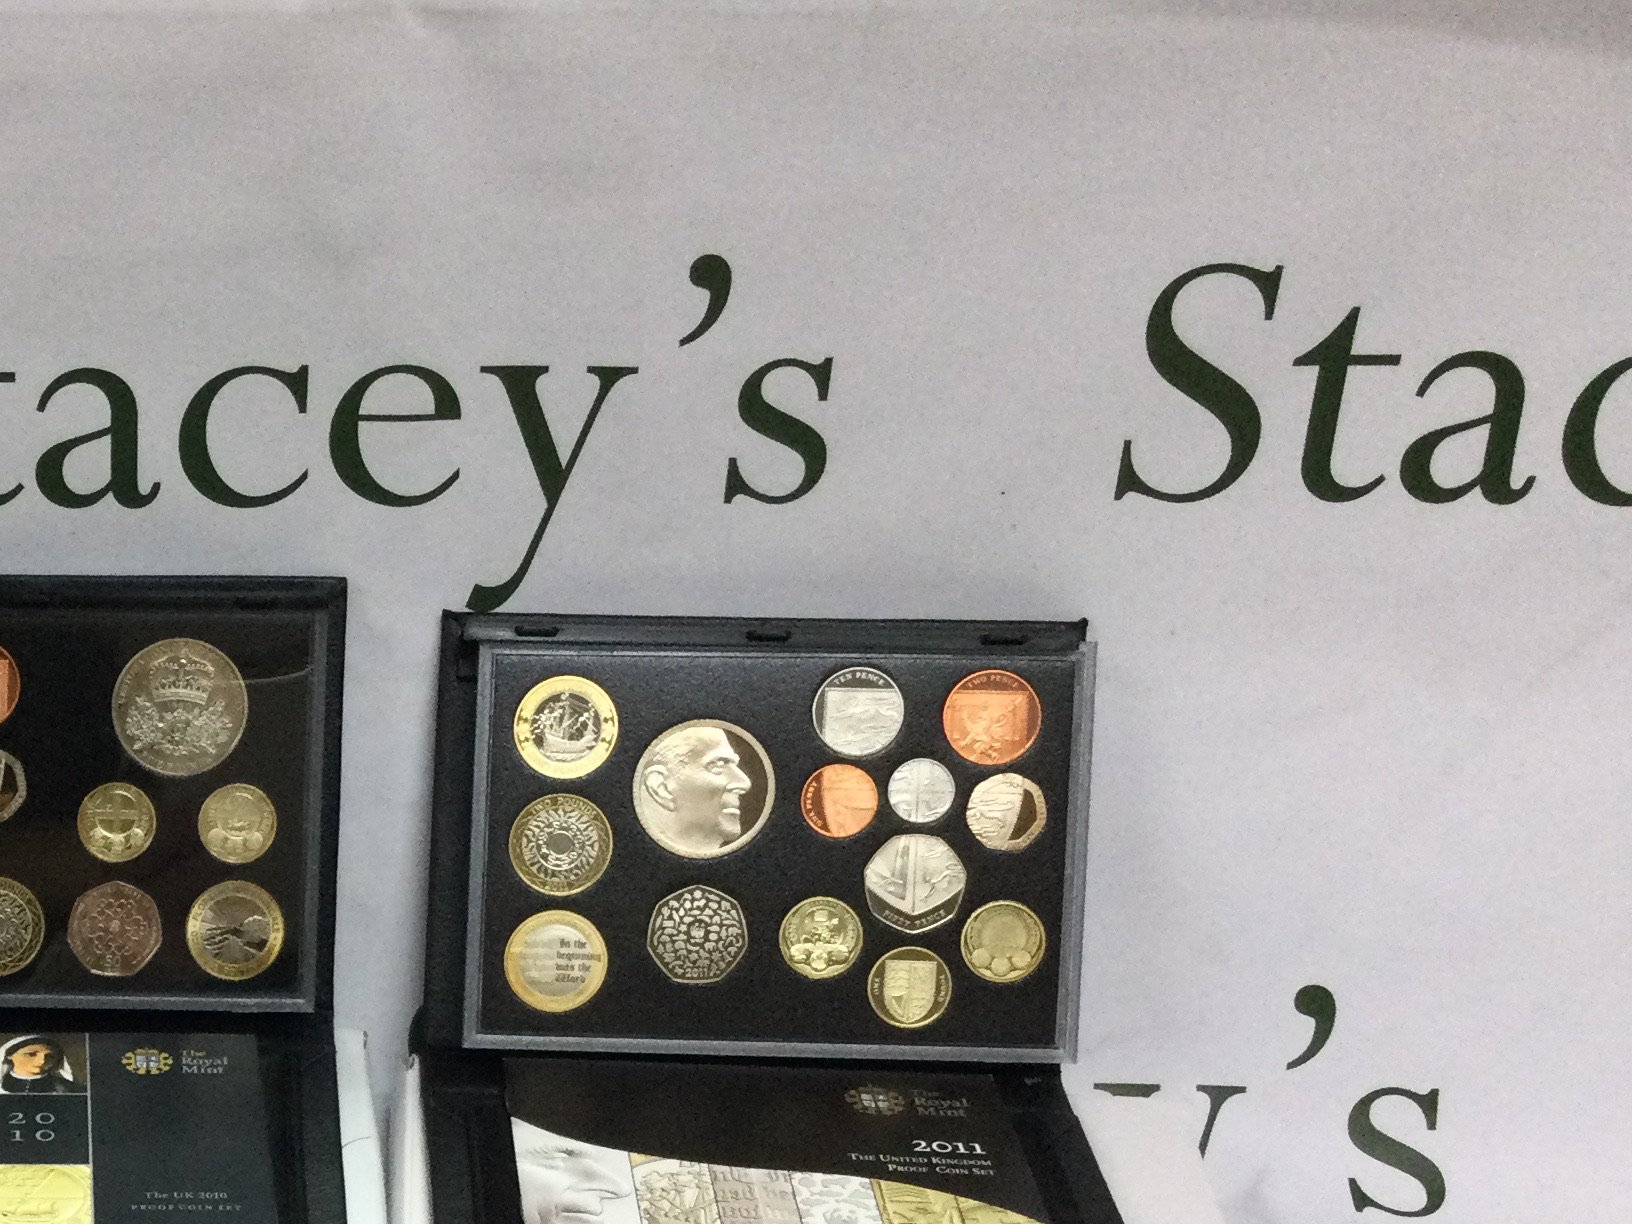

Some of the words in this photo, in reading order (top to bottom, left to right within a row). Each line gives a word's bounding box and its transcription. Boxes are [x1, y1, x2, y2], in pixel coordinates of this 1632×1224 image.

[832, 672, 854, 686] TEN
[855, 671, 886, 687] PENCE
[967, 675, 989, 689] TWO
[684, 967, 710, 980] 2011
[181, 1055, 228, 1067] Royal
[7, 1112, 57, 1126] 20
[9, 1129, 57, 1143] 10
[911, 1138, 989, 1156] 2011
[172, 1190, 195, 1200] UK
[197, 1190, 229, 1200] 2010
